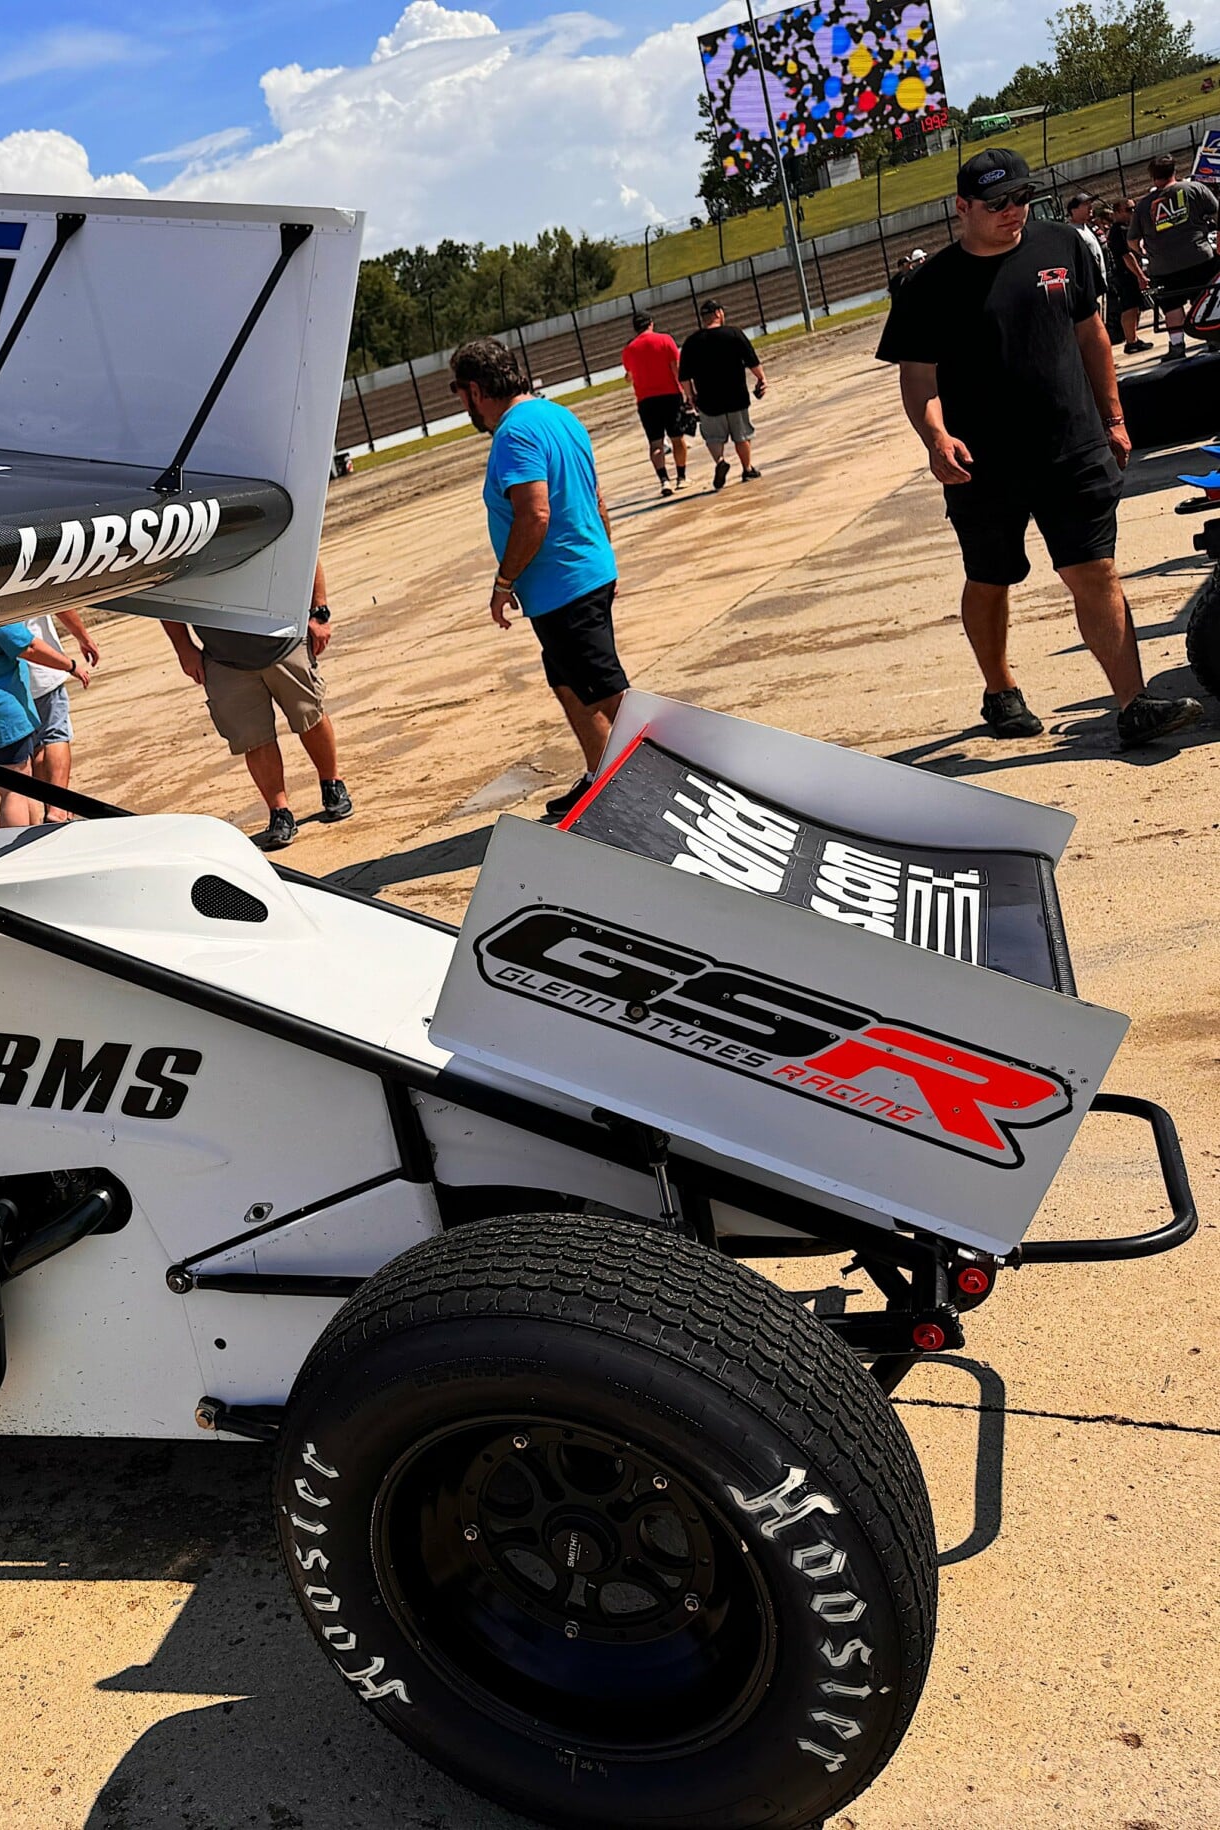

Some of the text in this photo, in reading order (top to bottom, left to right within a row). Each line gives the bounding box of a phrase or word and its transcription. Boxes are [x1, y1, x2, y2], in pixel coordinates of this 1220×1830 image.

[485, 907, 1058, 1150] GSR
[495, 966, 617, 1013] GLENN
[772, 1064, 924, 1122] RACING
